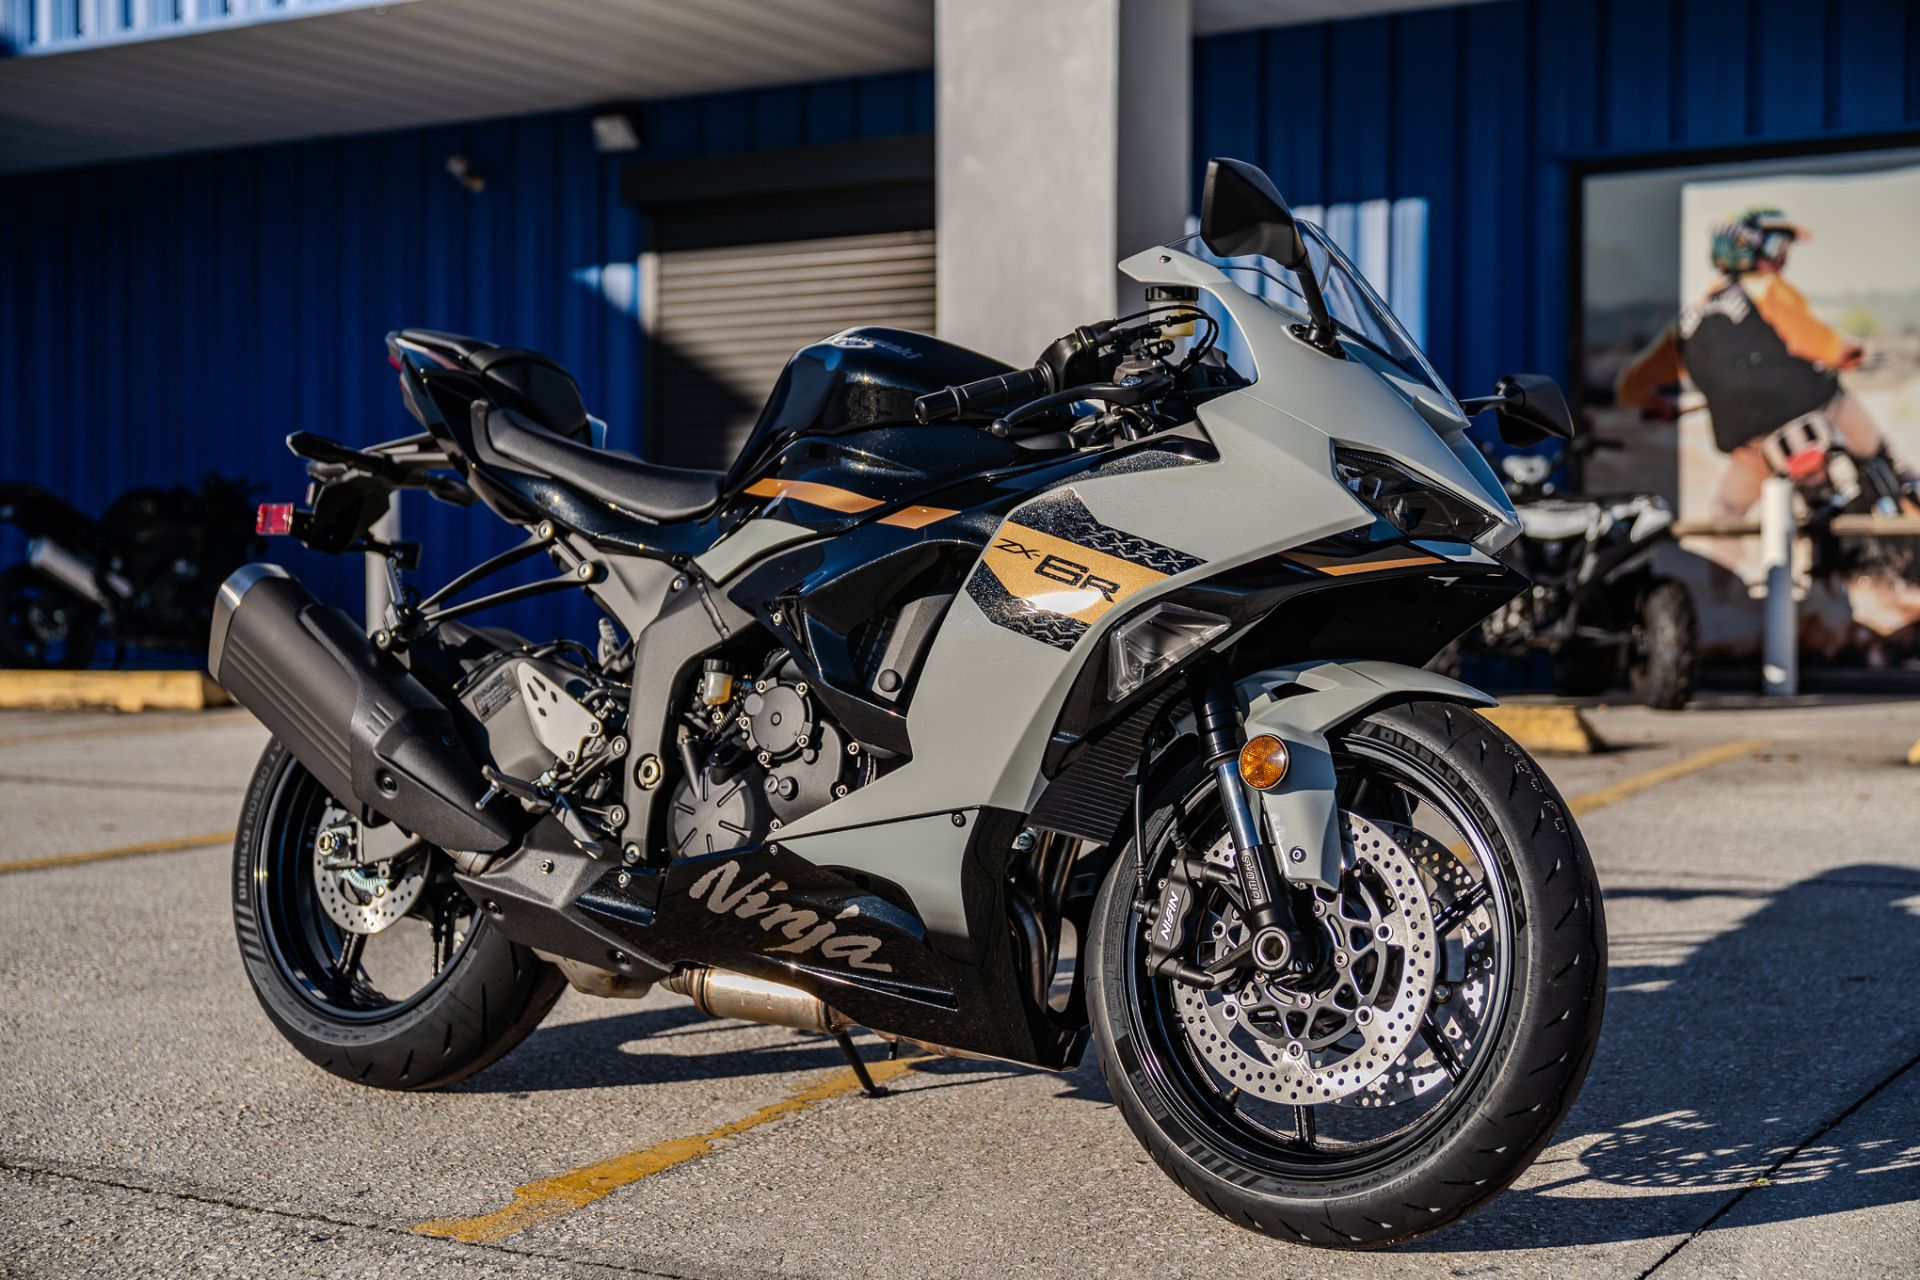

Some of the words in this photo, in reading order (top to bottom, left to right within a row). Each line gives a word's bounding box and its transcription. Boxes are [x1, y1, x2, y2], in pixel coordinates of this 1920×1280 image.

[1241, 854, 1262, 899] SHOWA
[688, 859, 893, 973] Ninja
[1160, 890, 1179, 941] NISSIN
